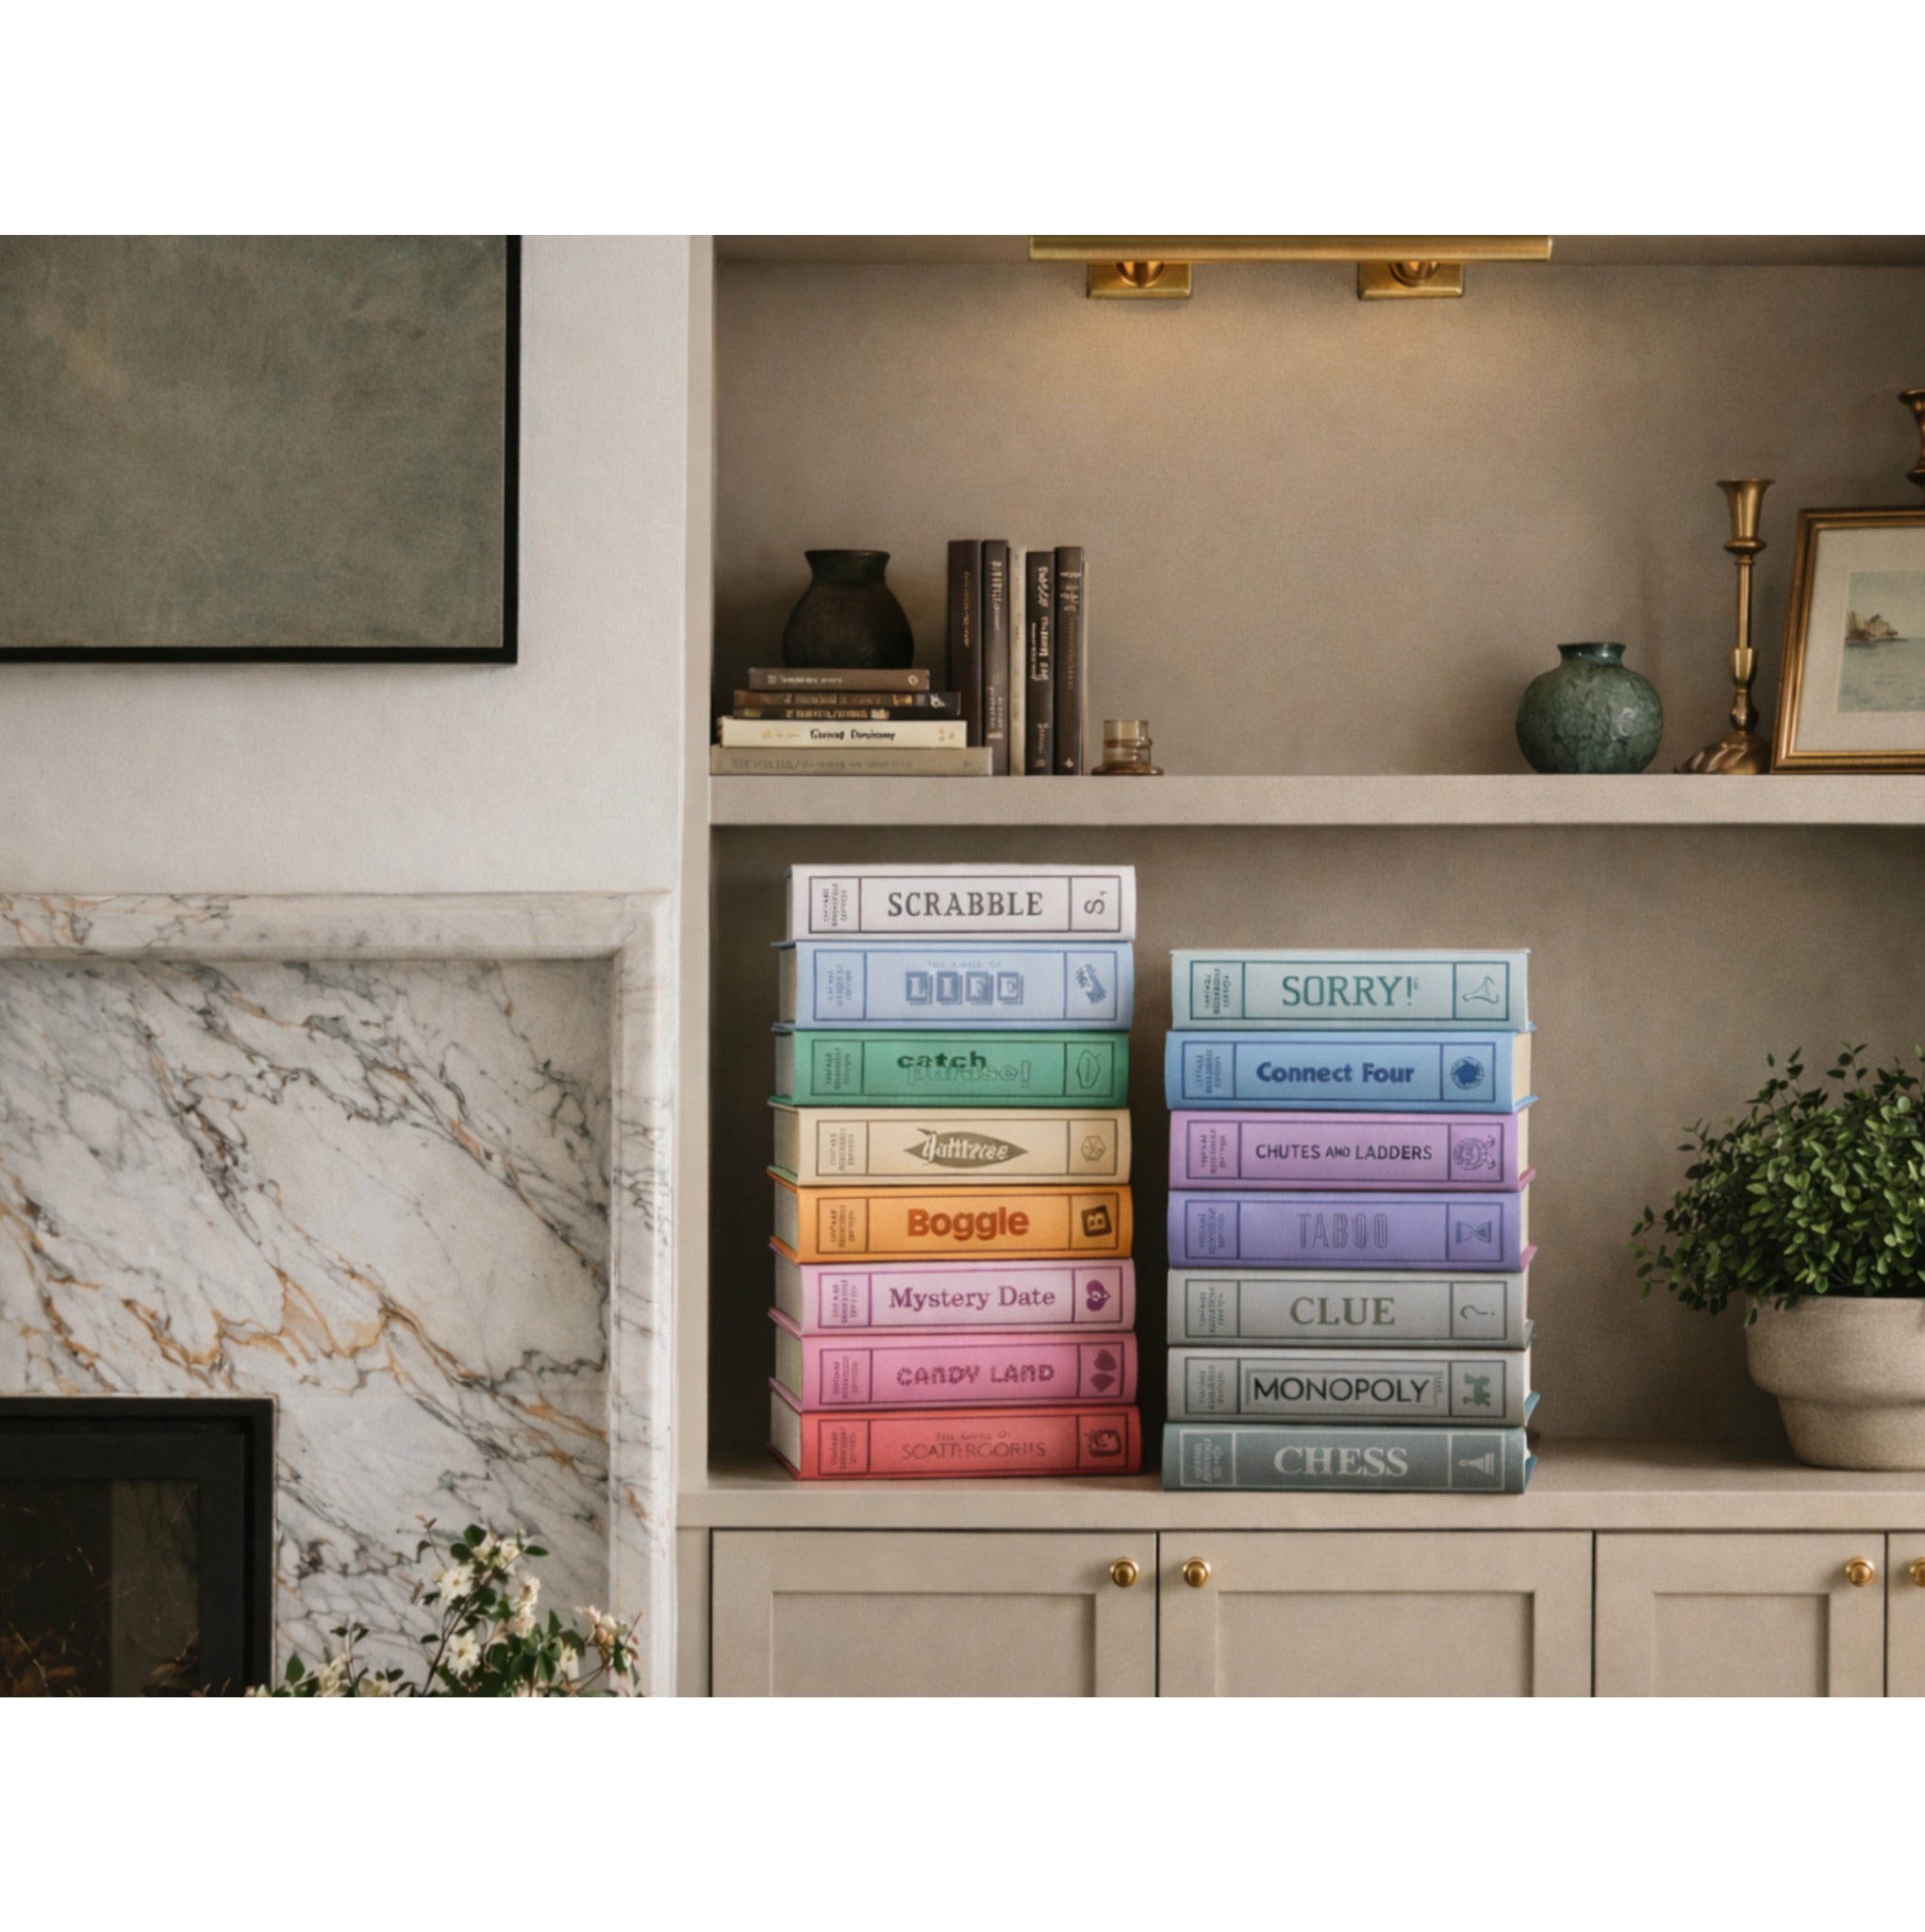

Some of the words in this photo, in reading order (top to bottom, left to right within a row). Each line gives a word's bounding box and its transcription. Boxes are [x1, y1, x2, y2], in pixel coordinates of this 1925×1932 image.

[888, 892, 1044, 917] SCRABBLE
[1282, 975, 1412, 1007] SORRY!
[897, 1051, 987, 1069] catch
[1256, 1062, 1352, 1084] Connect
[1363, 1063, 1415, 1084] Four
[1256, 1144, 1320, 1160] CHUTES
[1355, 1144, 1433, 1161] LADDERS
[907, 1207, 1030, 1242] Boggle
[1298, 1212, 1388, 1249] TABOO
[889, 1288, 990, 1313] Mystery
[998, 1286, 1056, 1307] Date
[1290, 1296, 1396, 1326] CLUE
[896, 1365, 981, 1387] CANDY
[991, 1364, 1055, 1385] LAND
[1254, 1377, 1430, 1403] MONOPOLY
[1273, 1445, 1408, 1477] CHESS
